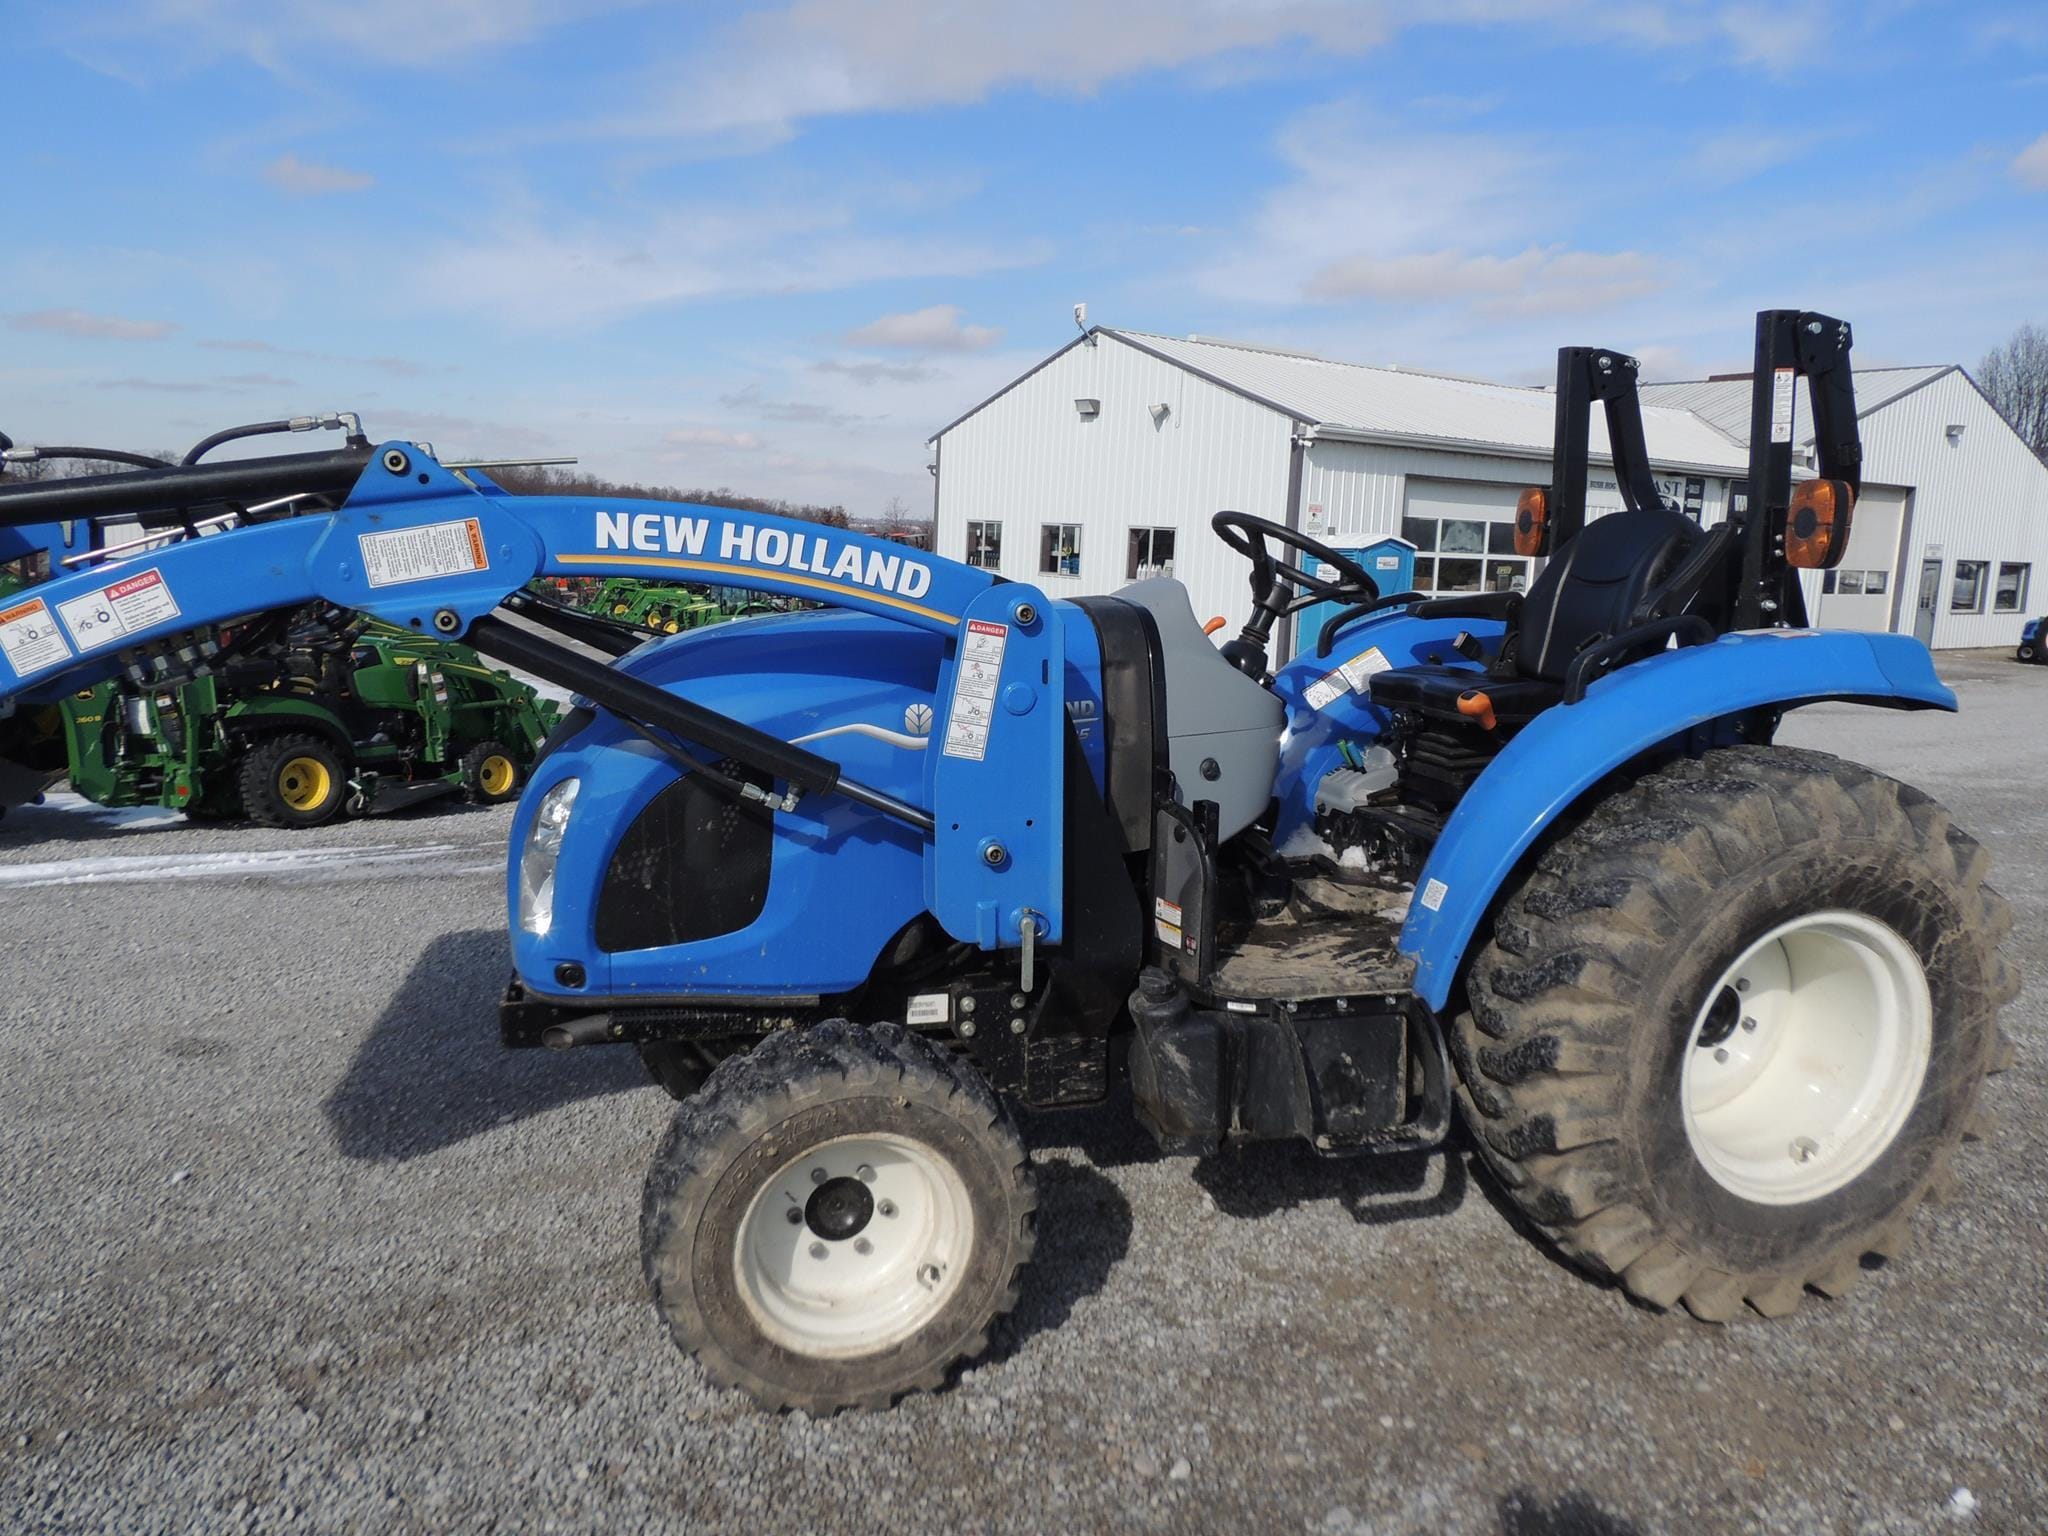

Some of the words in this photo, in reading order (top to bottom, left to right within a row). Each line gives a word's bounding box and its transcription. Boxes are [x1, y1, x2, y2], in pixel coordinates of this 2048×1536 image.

[471, 533, 483, 565] WARNING
[596, 511, 709, 555] NEW
[720, 522, 932, 599] HOLLAND
[119, 574, 156, 593] DANGER
[976, 625, 1005, 635] DANGER
